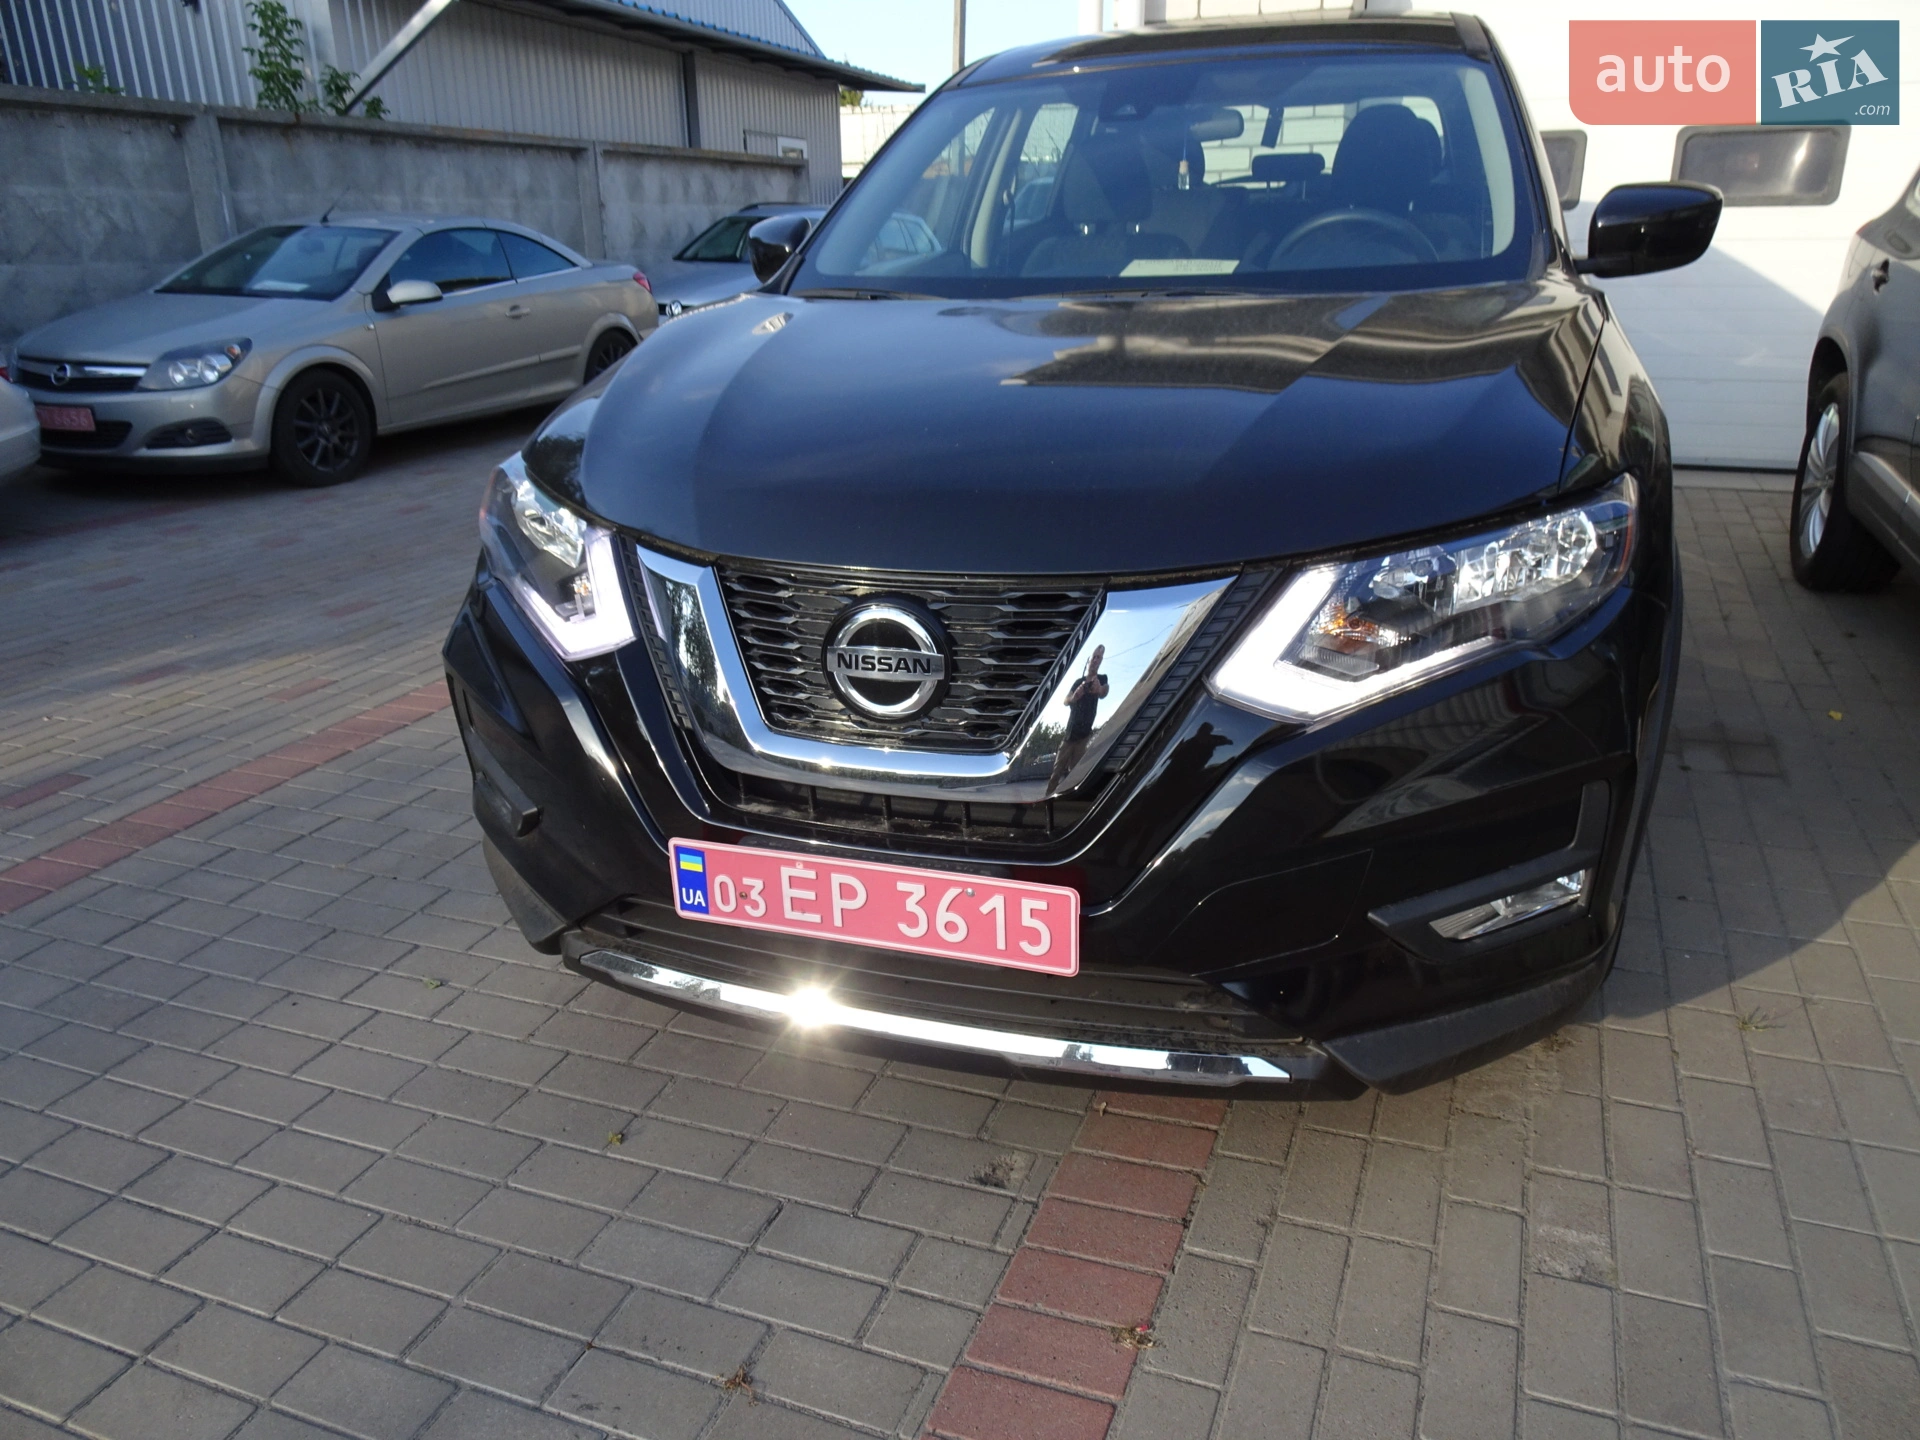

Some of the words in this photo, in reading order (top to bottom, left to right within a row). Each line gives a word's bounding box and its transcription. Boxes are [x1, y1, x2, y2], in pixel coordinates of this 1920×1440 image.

[837, 652, 931, 674] NISSAN
[681, 887, 706, 907] UA
[713, 874, 767, 918] 03
[780, 865, 868, 928] EP
[896, 880, 1052, 957] 3615
